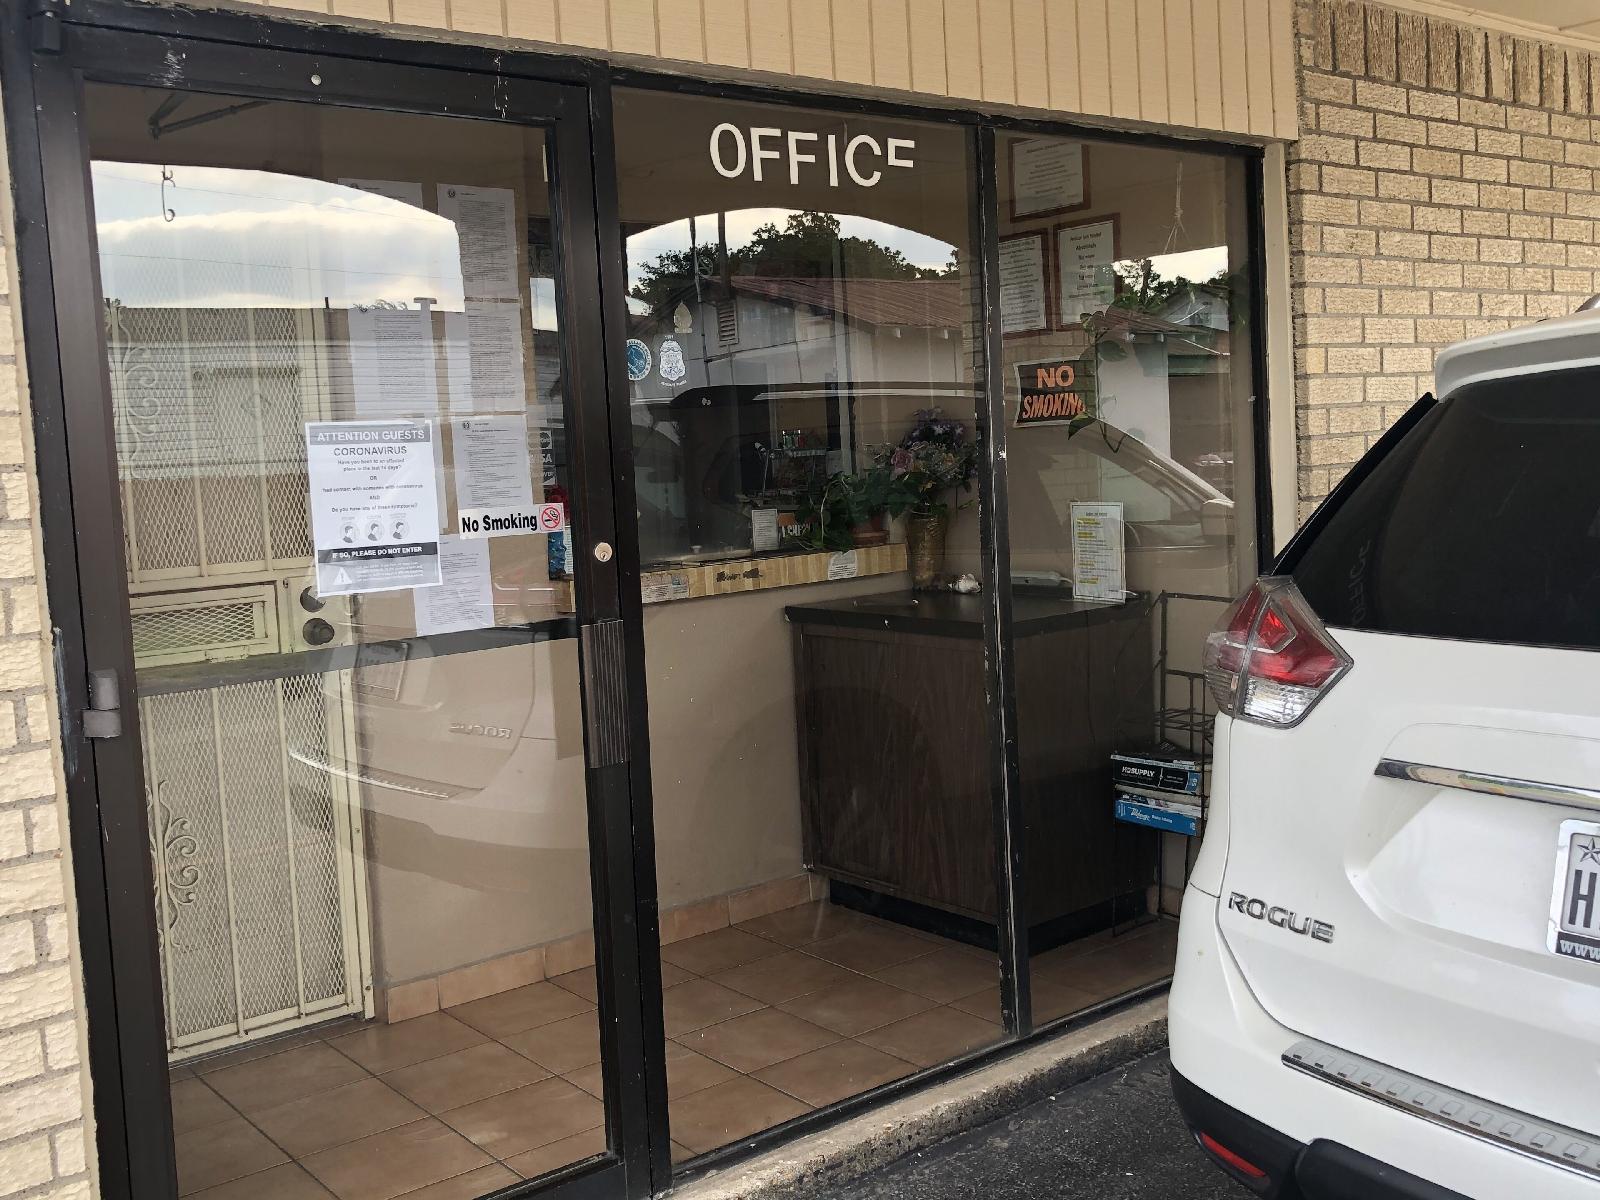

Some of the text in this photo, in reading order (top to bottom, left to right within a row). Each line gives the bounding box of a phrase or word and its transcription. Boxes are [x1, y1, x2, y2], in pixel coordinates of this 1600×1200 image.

[709, 122, 915, 187] OFFICE
[1037, 365, 1075, 389] NO
[317, 429, 425, 442] ATTENTION GUESTS
[333, 446, 407, 456] CORONAVIRUS
[462, 513, 538, 533] No Smoking
[351, 549, 377, 557] PLEASE
[402, 546, 423, 554] ENTER
[1228, 891, 1336, 944] ROGUE
